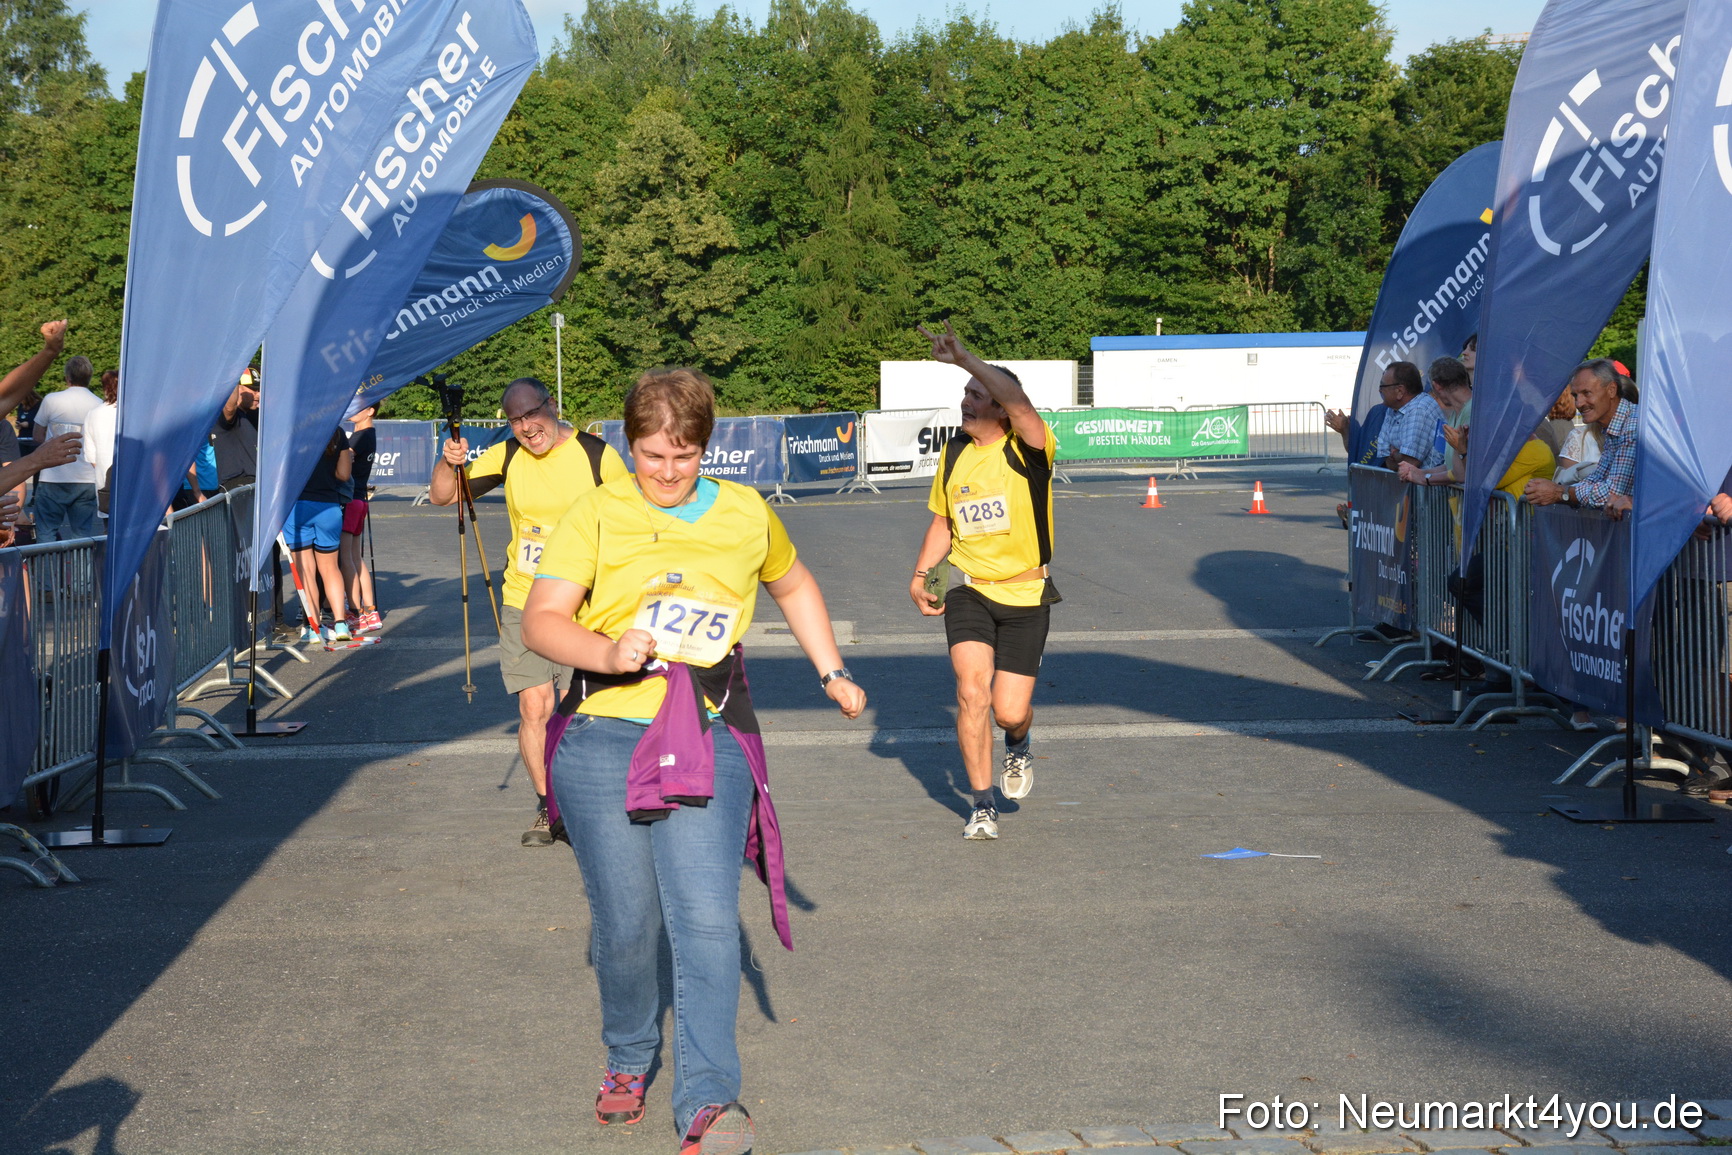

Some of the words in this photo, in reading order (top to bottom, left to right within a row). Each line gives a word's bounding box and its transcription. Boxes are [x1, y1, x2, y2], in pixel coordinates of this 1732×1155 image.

[340, 11, 480, 241] Fischer
[391, 55, 498, 238] AUTOMOBILE
[439, 295, 484, 328] Druck
[485, 284, 512, 303] und
[511, 254, 564, 289] Medien
[1456, 273, 1485, 309] Druck
[1074, 419, 1164, 434] GESUNDHEIT
[1096, 434, 1128, 446] BESTEN
[1131, 433, 1171, 446] HÄNDEN
[1192, 415, 1240, 440] AOK
[788, 435, 839, 454] Frischmann
[819, 453, 830, 462] Druck
[831, 452, 840, 461] und
[959, 501, 1005, 523] 1283
[646, 600, 729, 641] 1275
[1562, 587, 1625, 650] Fischer
